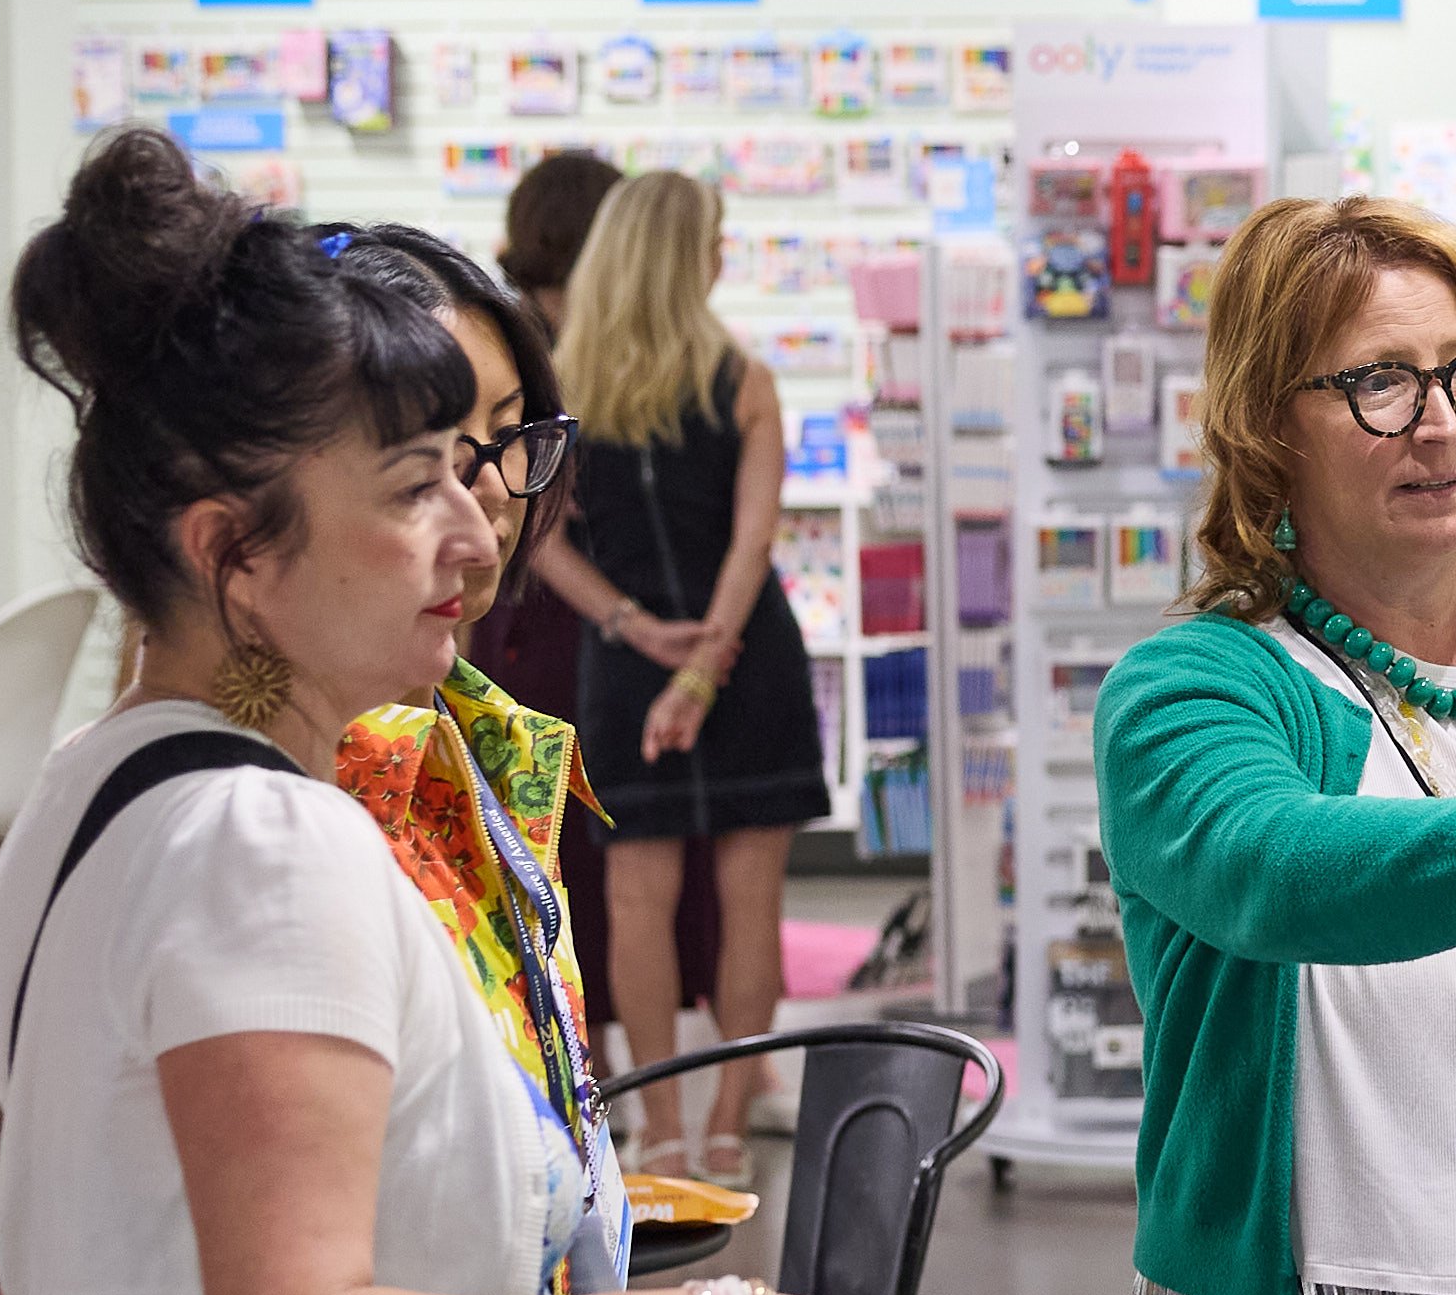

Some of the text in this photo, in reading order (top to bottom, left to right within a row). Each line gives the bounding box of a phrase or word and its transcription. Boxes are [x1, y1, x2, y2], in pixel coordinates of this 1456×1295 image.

[1028, 34, 1126, 84] ooly
[489, 806, 527, 863] America
[538, 1021, 556, 1058] 20
